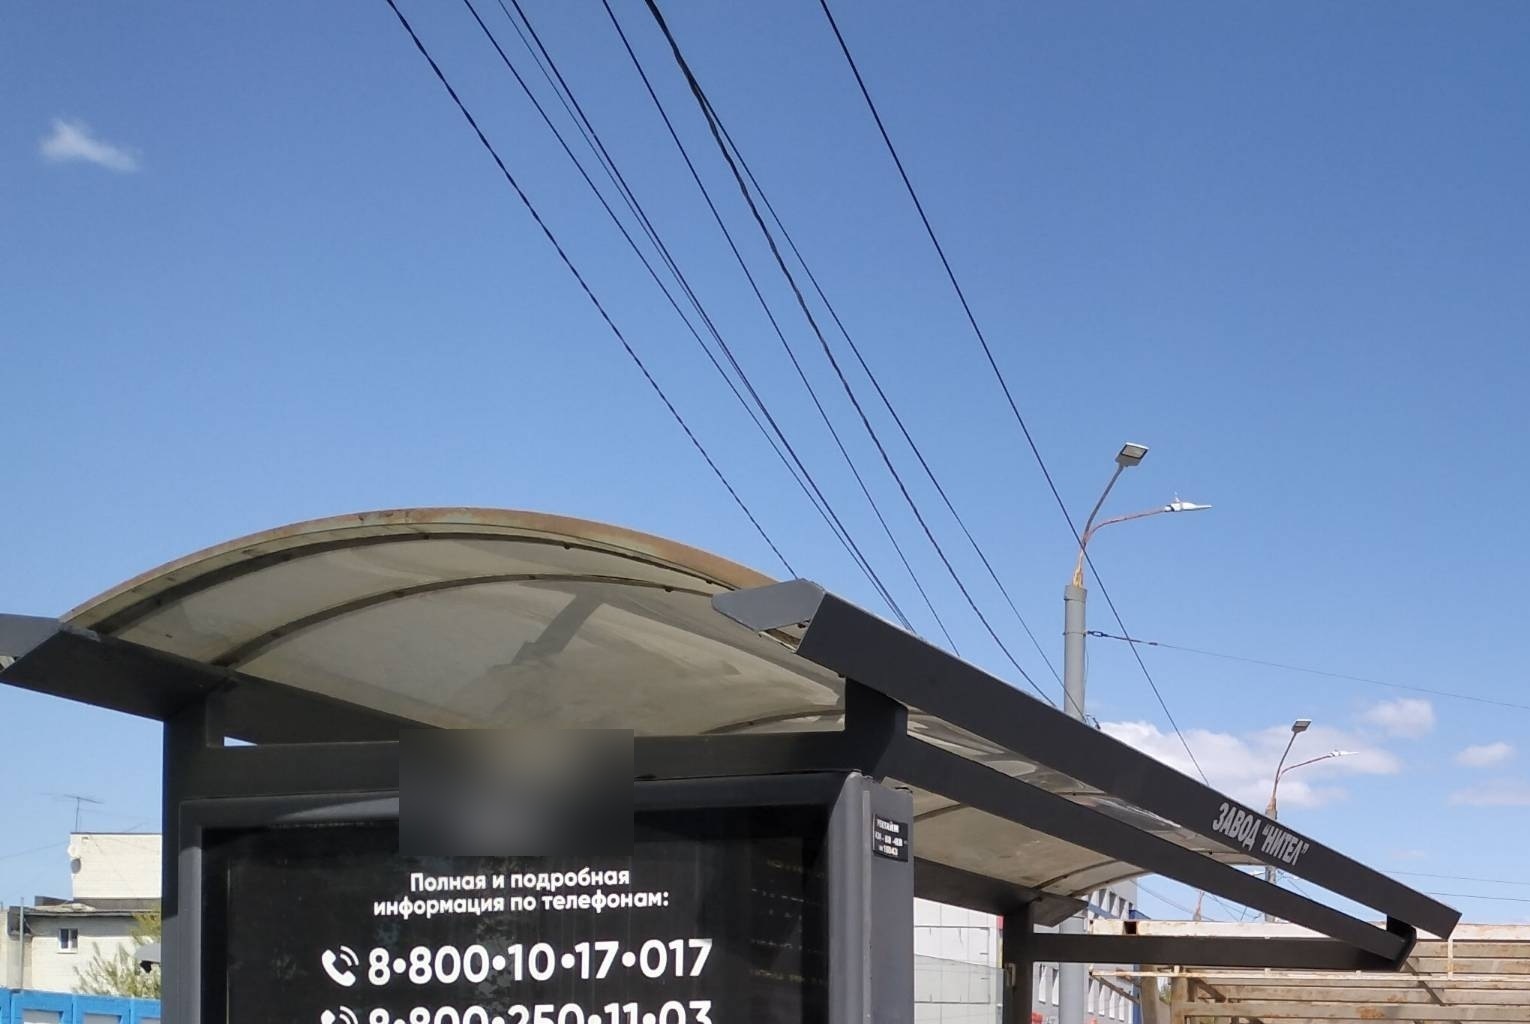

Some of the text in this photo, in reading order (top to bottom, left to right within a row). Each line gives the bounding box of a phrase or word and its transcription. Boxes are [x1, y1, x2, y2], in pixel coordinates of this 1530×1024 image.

[1212, 802, 1262, 852] ЗАВОД
[410, 867, 630, 892] Полная и подробная
[374, 889, 669, 920] информация по телефонам:
